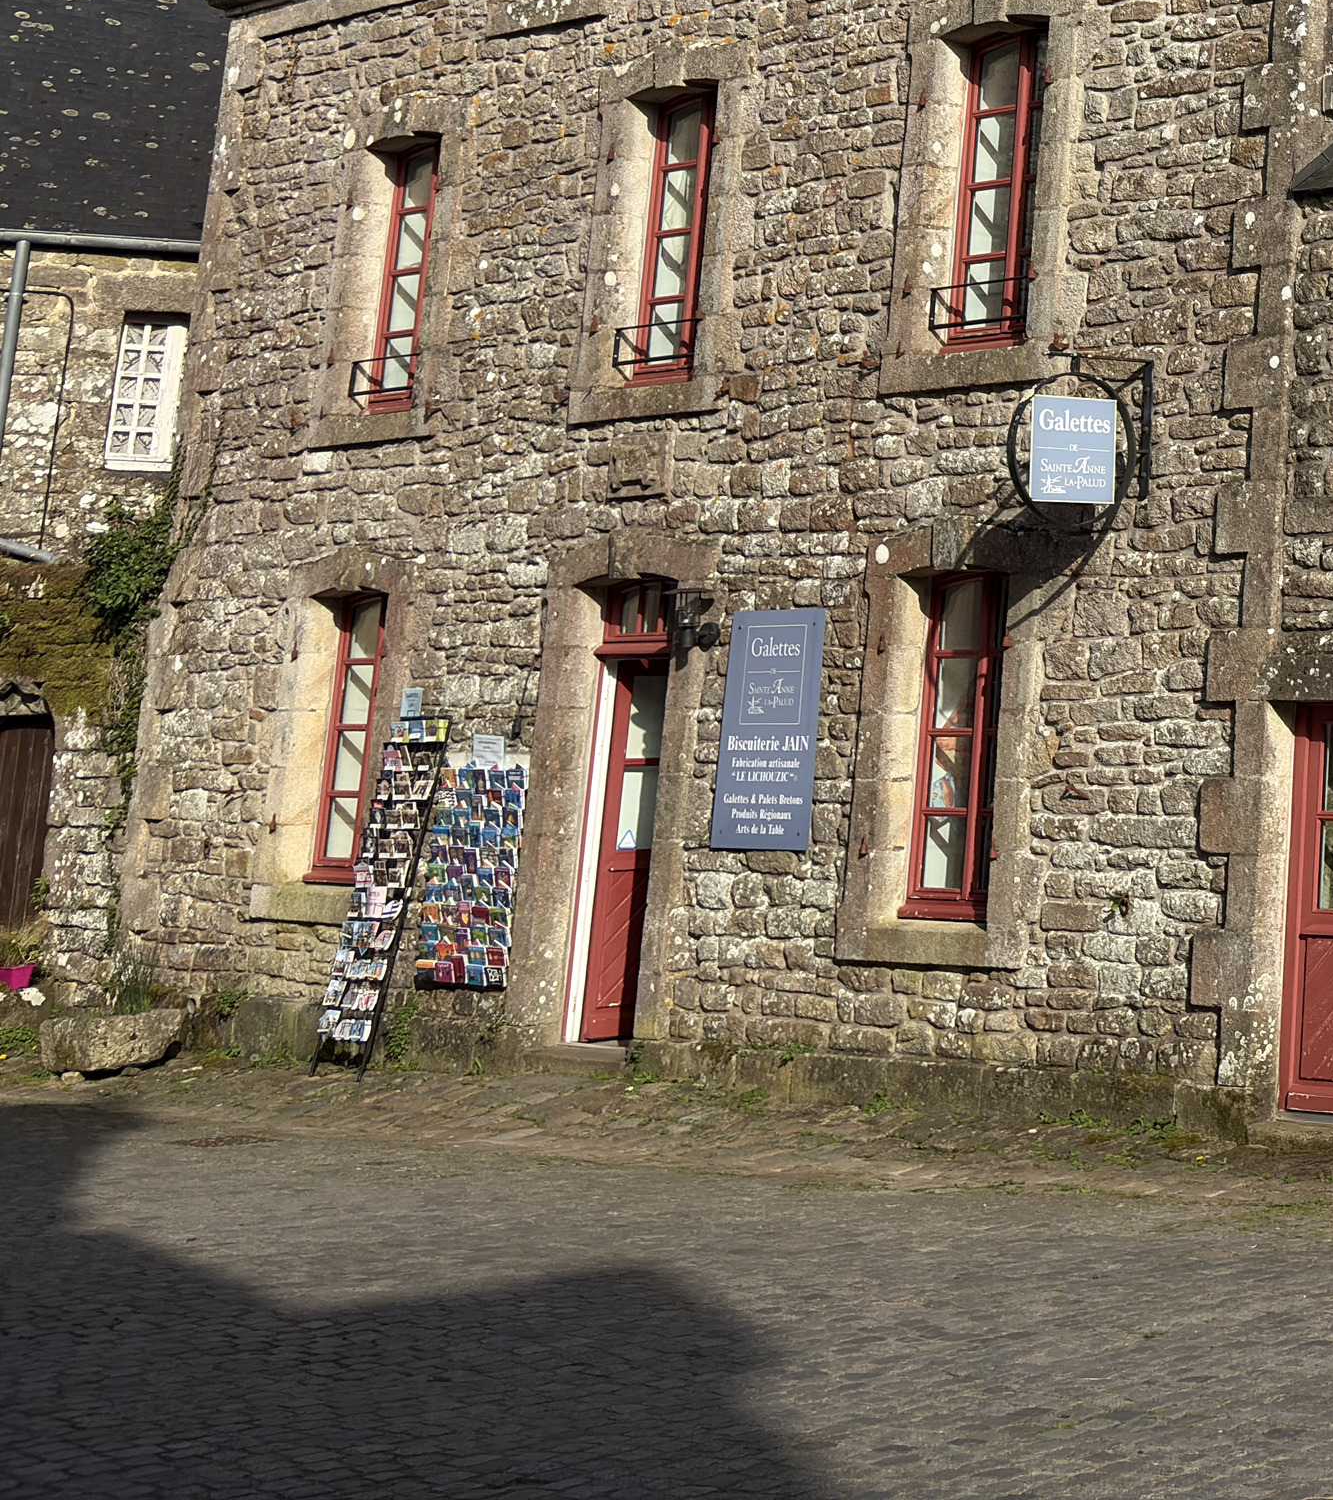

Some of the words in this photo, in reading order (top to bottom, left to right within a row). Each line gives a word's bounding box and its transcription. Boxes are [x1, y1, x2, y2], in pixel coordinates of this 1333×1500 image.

[1039, 408, 1111, 434] Galettes
[1069, 444, 1078, 452] DE
[1040, 457, 1073, 473] SAINTE
[1073, 456, 1106, 475] ANNE
[751, 636, 801, 657] Galettes
[727, 735, 780, 751] Biscuiterie
[782, 735, 809, 751] JAIN
[732, 757, 767, 768] Fabrication
[768, 757, 800, 768] artisanale
[723, 793, 749, 804] Galettes
[751, 793, 756, 804] &
[758, 794, 778, 804] Palets
[779, 794, 803, 805] Bretons
[731, 808, 758, 819] Produits
[736, 824, 749, 834] Arts
[751, 824, 759, 834] de
[760, 824, 766, 834] la
[768, 824, 785, 835] Table
